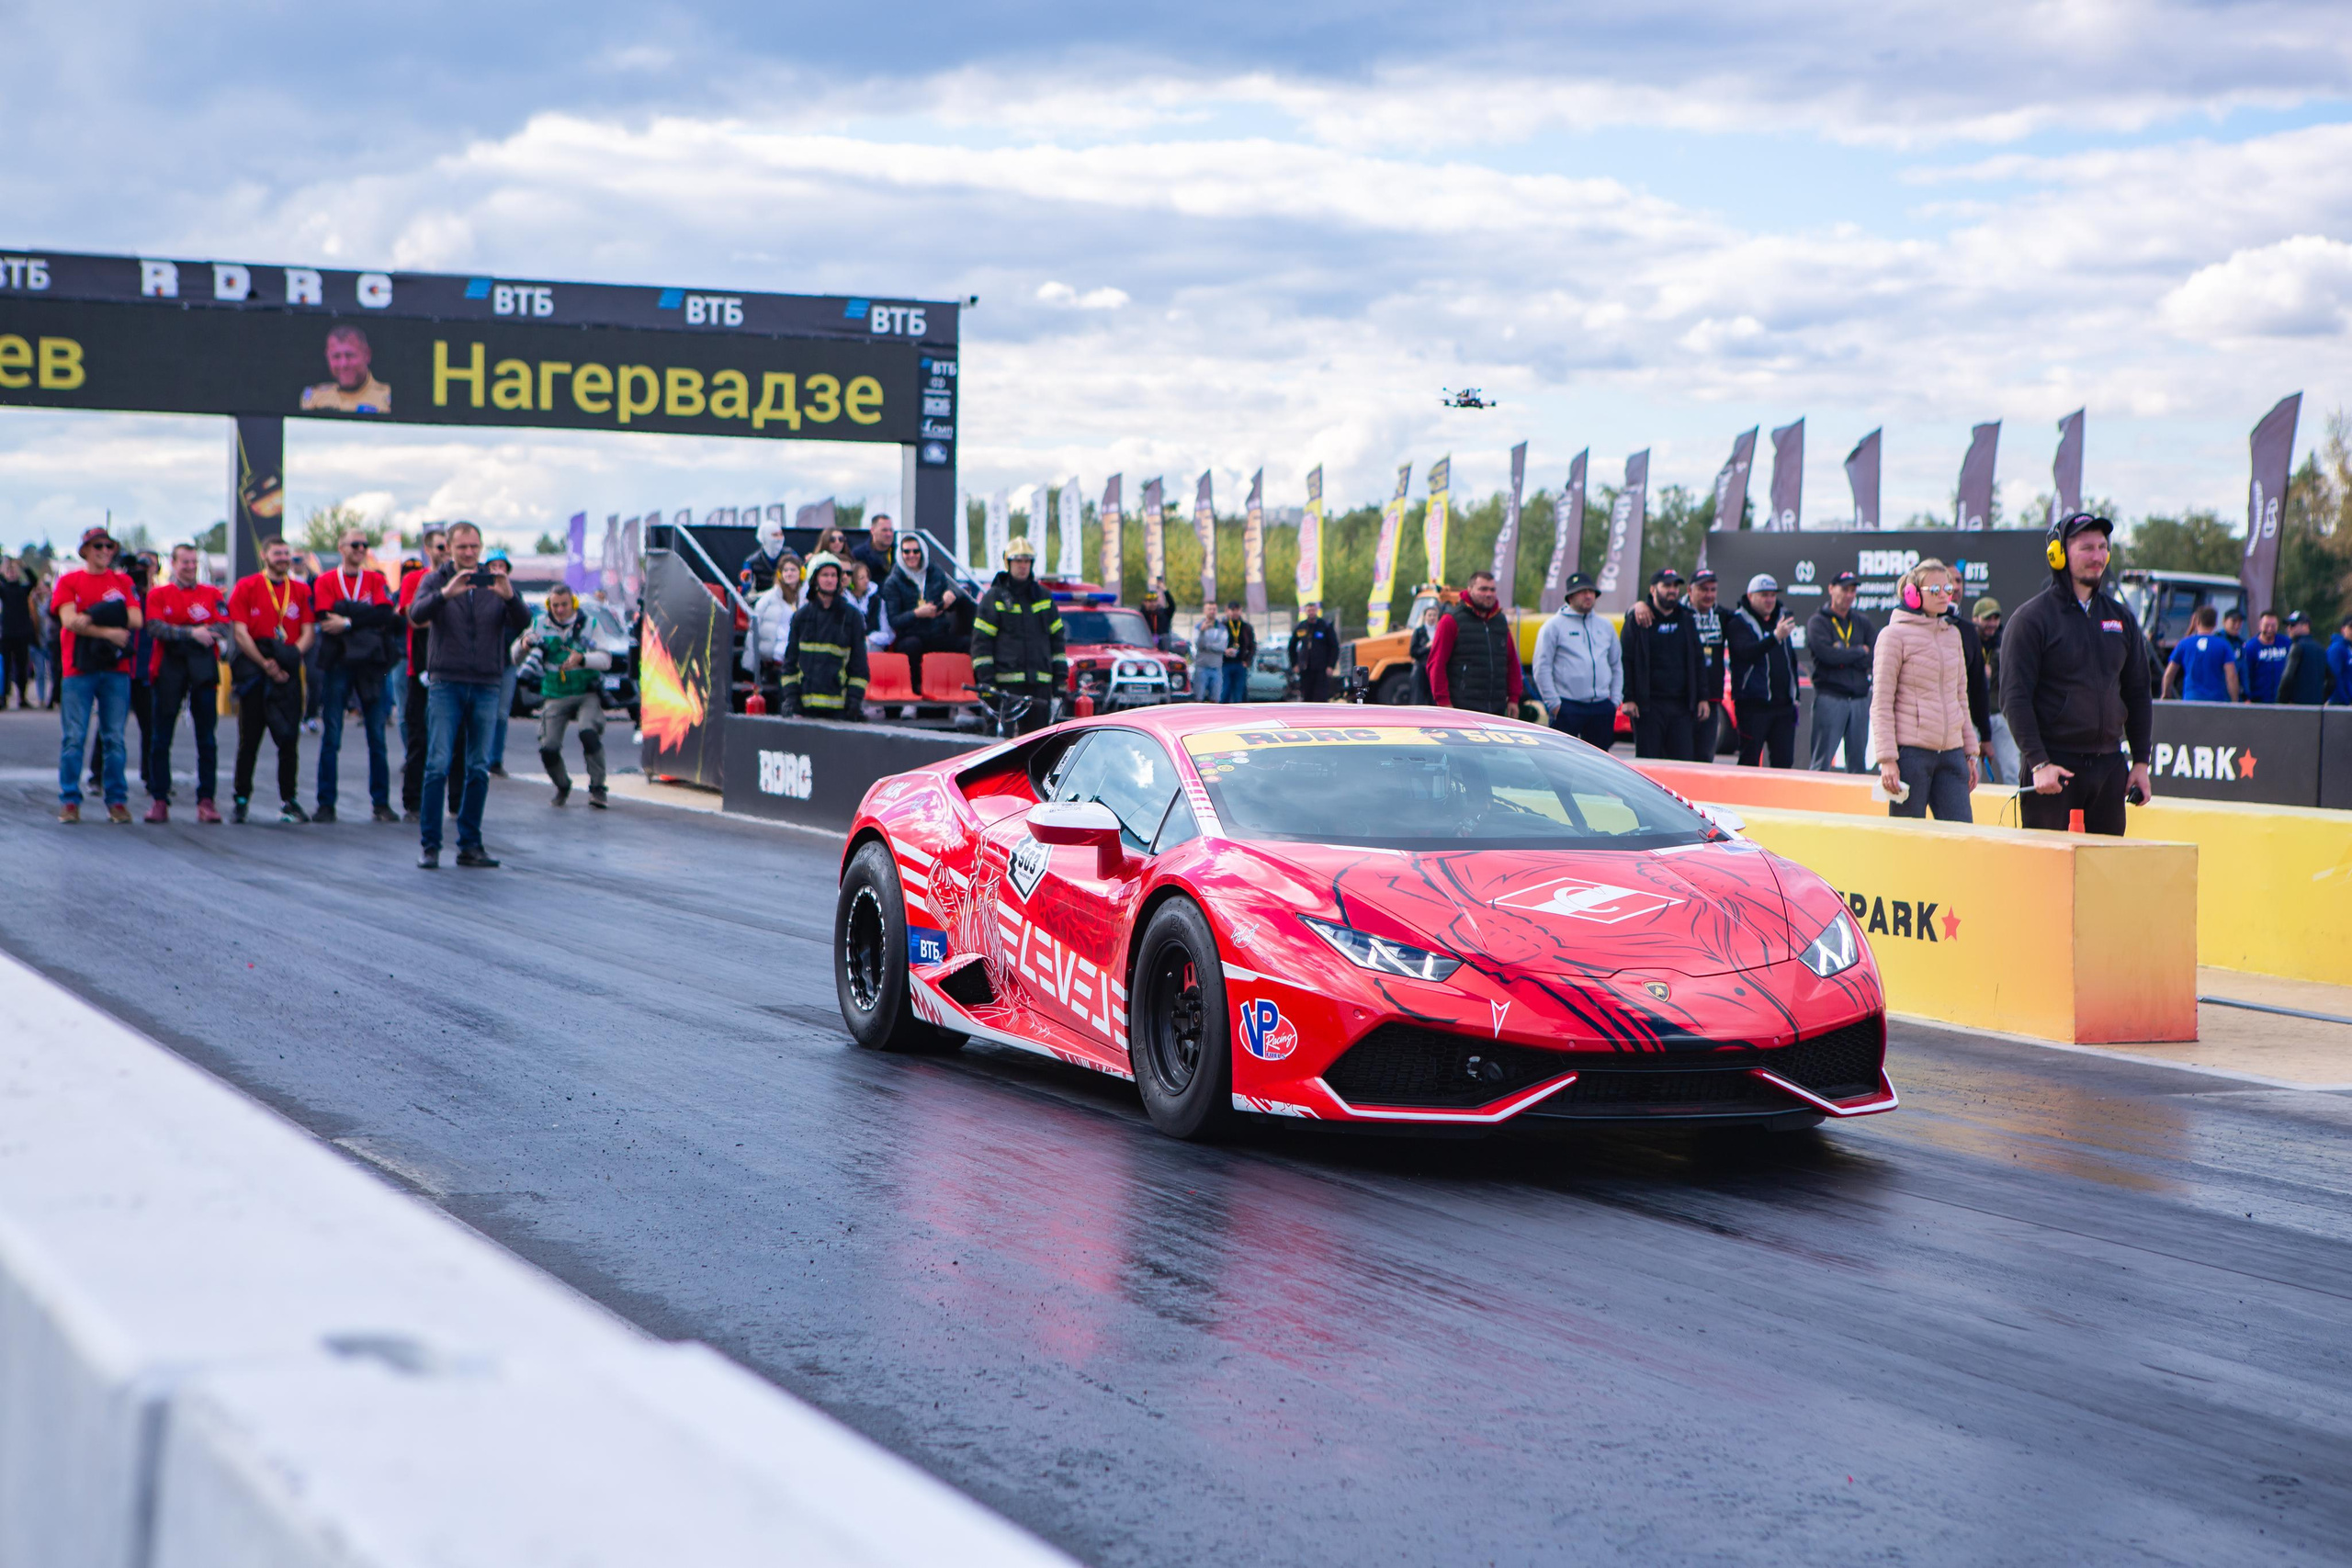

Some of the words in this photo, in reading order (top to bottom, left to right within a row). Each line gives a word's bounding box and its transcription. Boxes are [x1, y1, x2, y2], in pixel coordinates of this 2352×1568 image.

[492, 284, 553, 317] ВТБ
[685, 295, 744, 326] ВТБ
[870, 305, 927, 335] ВТБ
[932, 360, 956, 376] ВТБ
[433, 340, 885, 431] Нагервадзе
[1964, 561, 1989, 581] ВТБ
[1237, 728, 1382, 745] RDRC
[1458, 729, 1541, 747] 503
[2120, 740, 2236, 781] PARK
[1018, 846, 1042, 874] 503
[1838, 890, 1939, 942] PARK
[921, 939, 941, 960] ВТБ
[1240, 998, 1280, 1058] VP
[1265, 1032, 1294, 1052] Racing
[1265, 1051, 1287, 1060] FUELS
